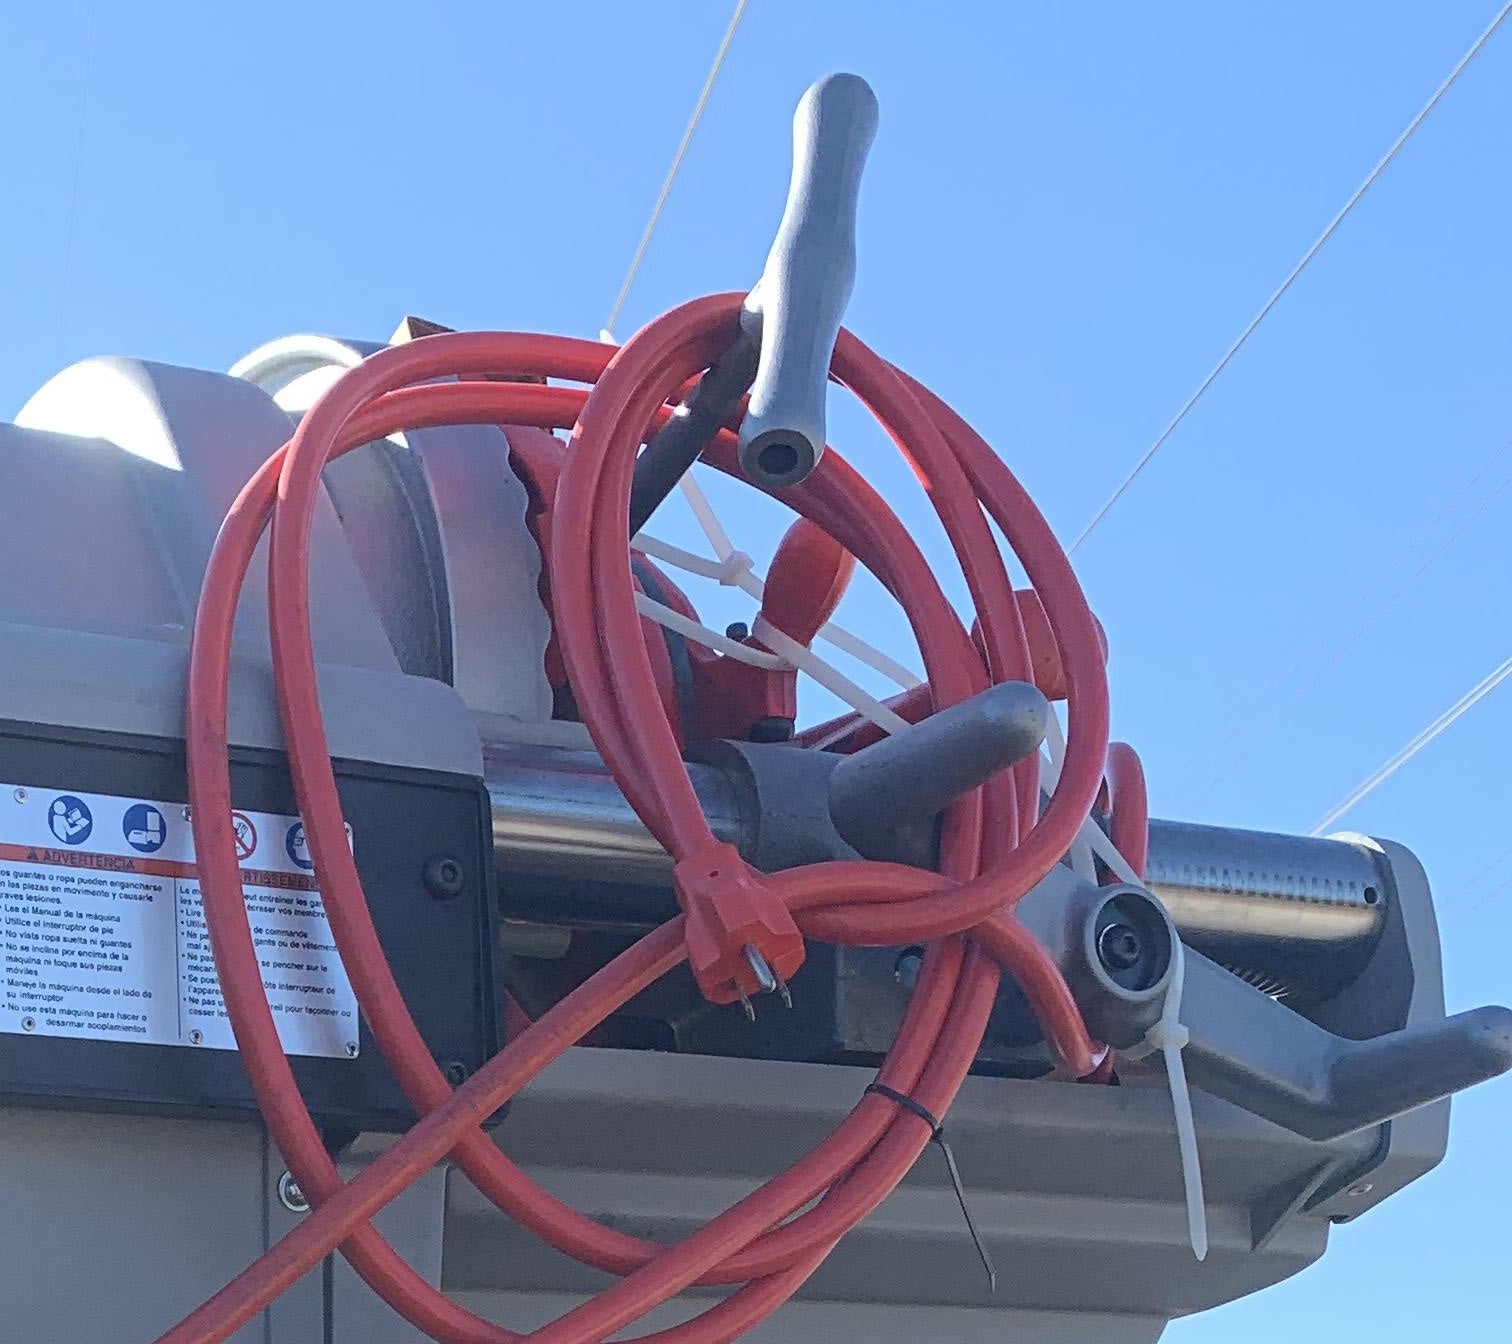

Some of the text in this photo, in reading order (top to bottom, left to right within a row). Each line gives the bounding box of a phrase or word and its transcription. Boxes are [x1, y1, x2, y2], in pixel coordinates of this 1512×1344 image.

[43, 850, 135, 870] ADVERTENCIA
[13, 871, 45, 881] guantes
[56, 876, 75, 884] ropa
[78, 877, 107, 886] pueden
[110, 881, 162, 892] engancharse
[23, 882, 49, 892] piezas
[244, 870, 315, 889] RTISSEMEN
[5, 904, 19, 913] Lea
[32, 907, 61, 917] Manual
[64, 910, 73, 918] de
[76, 911, 83, 919] la
[5, 917, 30, 927] Utilice
[6, 930, 17, 938] No
[20, 932, 38, 940] vista
[63, 936, 87, 945] suelta
[100, 940, 132, 949] guantes
[6, 943, 17, 951] No
[32, 945, 59, 955] incline
[78, 950, 107, 959] encima
[110, 952, 119, 960] de
[122, 953, 129, 961] la
[54, 959, 77, 969] toque
[80, 961, 94, 969] sus
[97, 963, 122, 972] piezas
[87, 985, 110, 995] desde
[123, 988, 140, 997] lado
[8, 1003, 19, 1011] No
[40, 1006, 56, 1014] esta
[97, 1010, 114, 1019] para
[117, 1011, 139, 1021] hacer
